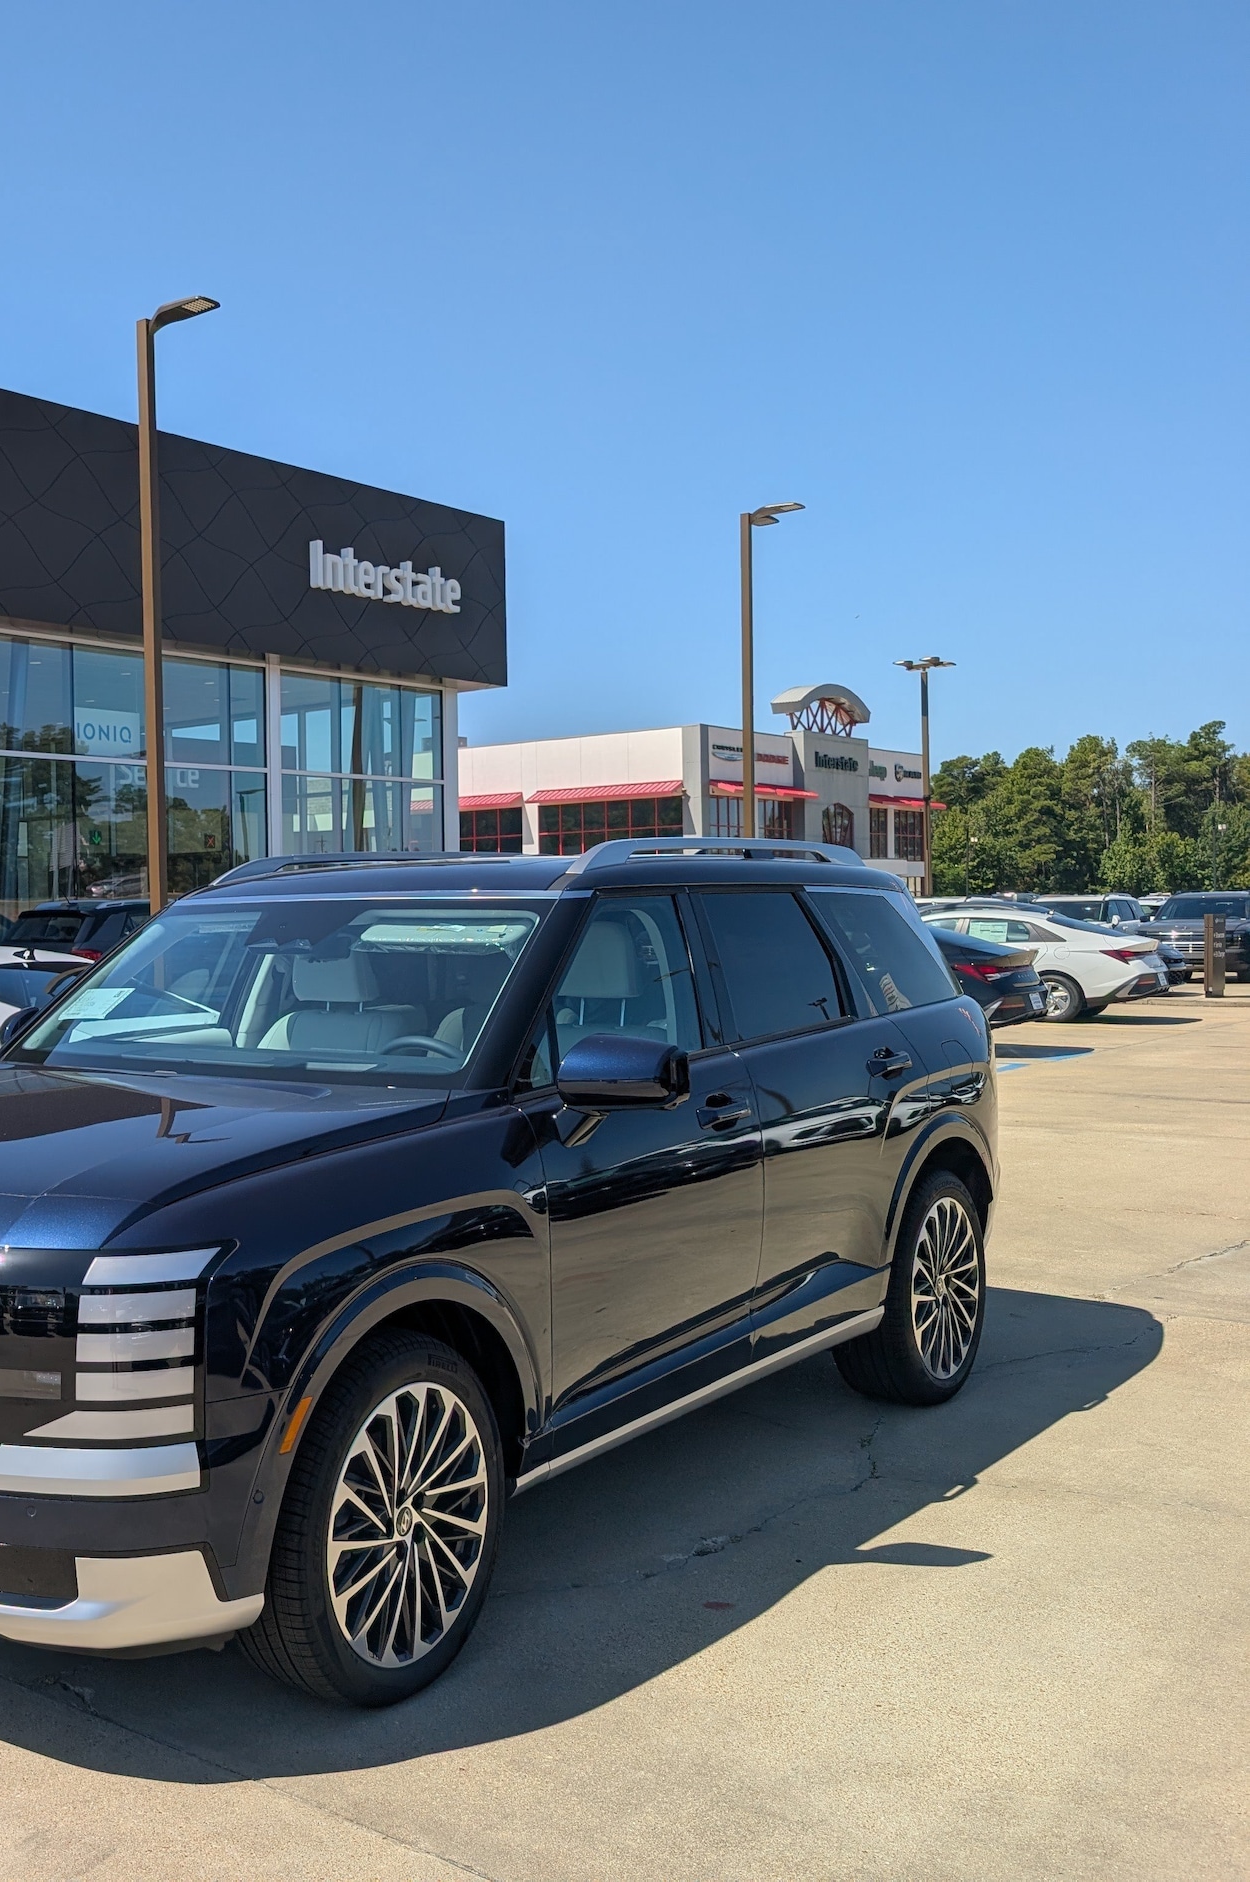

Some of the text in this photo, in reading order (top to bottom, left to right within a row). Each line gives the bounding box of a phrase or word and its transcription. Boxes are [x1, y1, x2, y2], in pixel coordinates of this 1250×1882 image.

[309, 539, 461, 614] Interstate
[76, 722, 132, 743] IONIQ
[814, 751, 859, 772] Interstate
